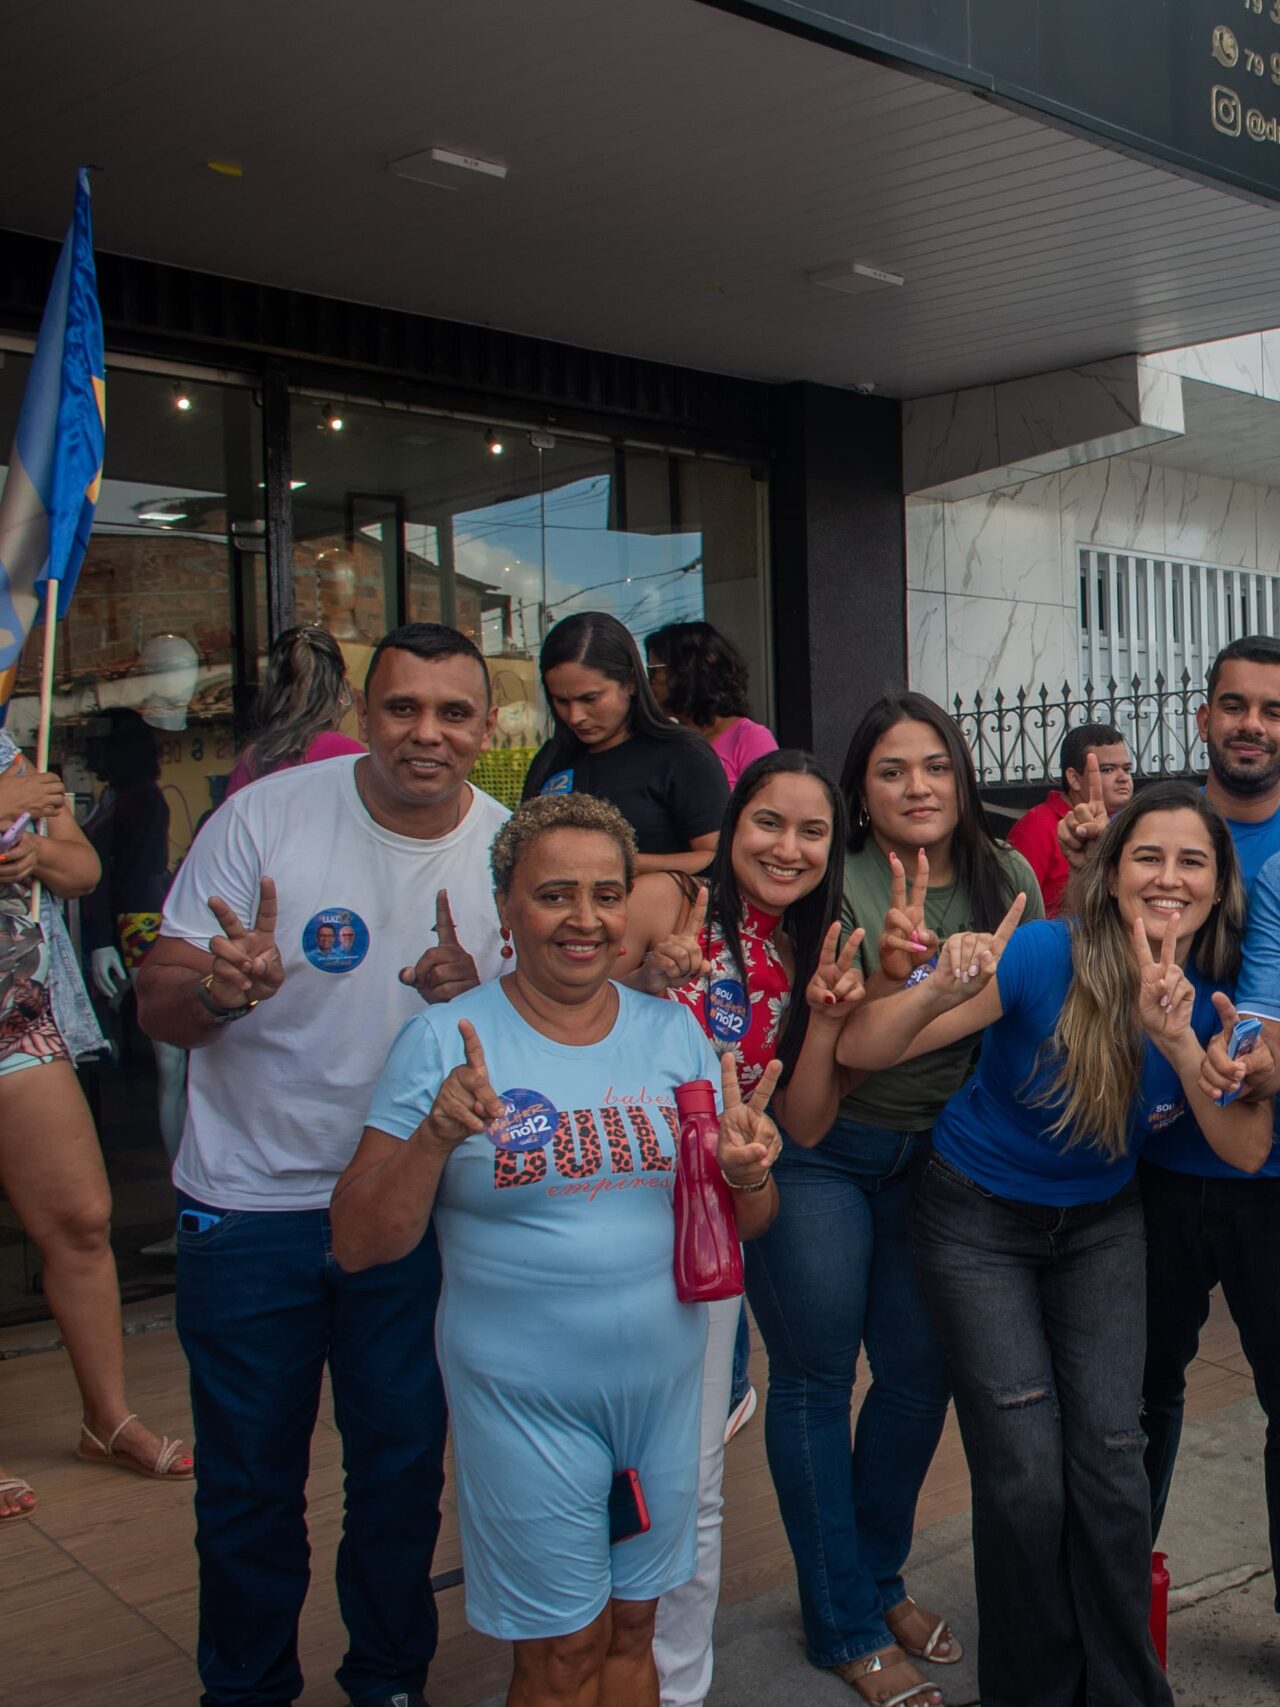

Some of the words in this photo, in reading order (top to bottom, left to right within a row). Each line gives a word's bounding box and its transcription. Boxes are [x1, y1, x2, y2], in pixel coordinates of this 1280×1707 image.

[1244, 49, 1265, 77] 79
[714, 986, 733, 1000] SOU
[545, 1174, 673, 1203] empires
